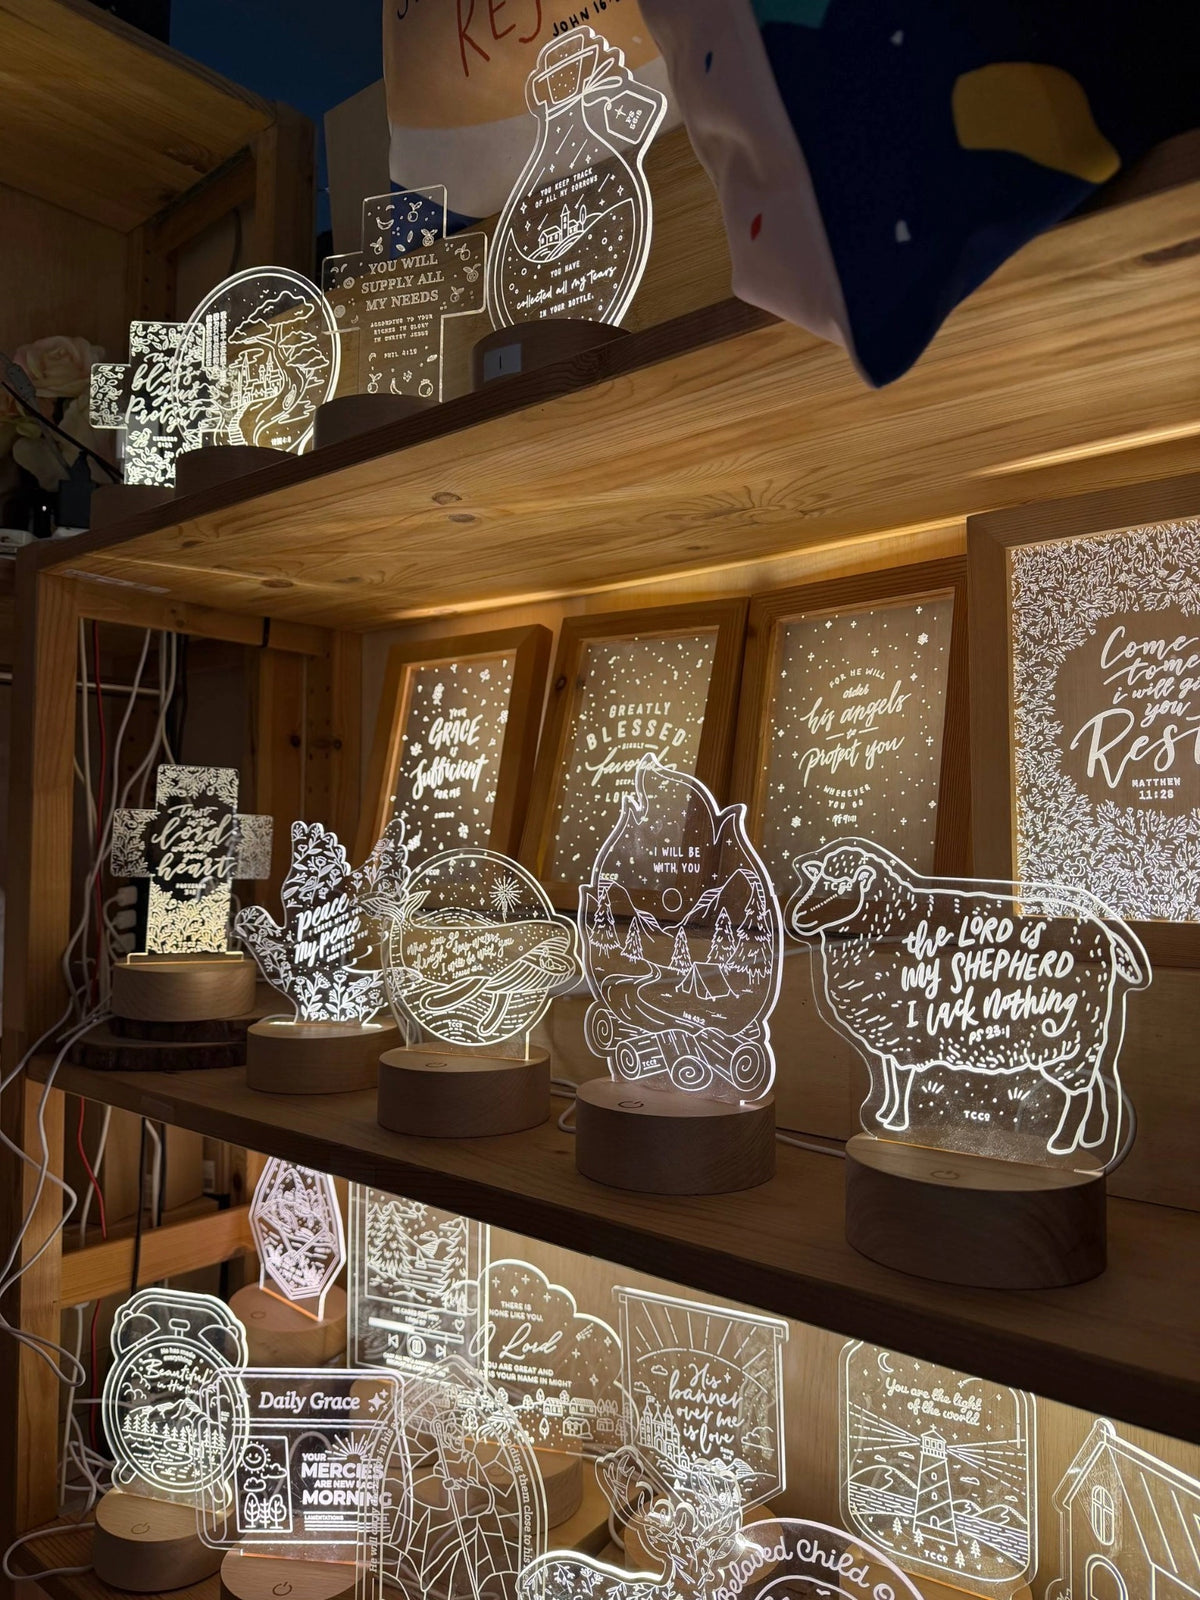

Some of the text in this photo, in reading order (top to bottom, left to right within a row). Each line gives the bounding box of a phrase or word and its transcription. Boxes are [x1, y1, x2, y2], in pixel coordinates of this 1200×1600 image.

[552, 12, 590, 38] JOHN
[535, 174, 598, 208] OF ALL MY SORROWS
[540, 167, 593, 197] YOU KEEP TRACK
[368, 253, 438, 275] YOU WILL
[550, 260, 580, 278] YOU HAVE
[361, 271, 444, 294] SUPPLY ALL
[516, 285, 552, 310] collected
[555, 280, 567, 294] all
[571, 275, 586, 292] my
[365, 289, 439, 312] MY NEEDS
[539, 309, 547, 318] IN
[550, 302, 565, 314] YOUR
[1101, 625, 1199, 669] Come
[829, 667, 886, 688] FOR HE WILL
[1131, 676, 1175, 700] will
[608, 702, 671, 719] GREATLY
[800, 680, 912, 734] his angels
[1140, 699, 1191, 728] you
[428, 713, 484, 751] GRACE
[586, 718, 686, 750] BLESSED
[865, 736, 905, 771] you
[823, 783, 871, 798] WHEREVER
[1131, 777, 1181, 788] MATTHEW
[1138, 789, 1175, 800] 11:28
[828, 798, 863, 810] YOU GO
[661, 846, 684, 857] WILL
[688, 846, 701, 858] BE
[155, 852, 238, 880] heart
[653, 862, 701, 873] WITH YOU
[445, 930, 460, 949] go
[902, 915, 1047, 960] the LORD is
[294, 940, 320, 968] my
[901, 949, 1075, 1000] my SHEPHERD
[906, 1000, 919, 1028] I
[983, 984, 1078, 1038] nothing
[985, 1024, 1011, 1040] 23:1
[489, 1308, 509, 1318] NONE
[510, 1311, 526, 1320] LIKE
[500, 1300, 532, 1311] THERE IS
[499, 1322, 563, 1361] Lord
[141, 1358, 210, 1386] Beautiful
[481, 1360, 554, 1377] YOU ARE GREAT AND
[496, 1371, 517, 1381] YOUR
[517, 1373, 539, 1384] NAME
[540, 1376, 548, 1385] IN
[548, 1378, 573, 1388] MIGHT
[688, 1362, 722, 1390] His
[668, 1369, 744, 1409] banner
[885, 1376, 983, 1414] You are the light
[258, 1390, 361, 1414] Daily Grace
[907, 1397, 981, 1427] of the world
[676, 1405, 745, 1428] over me
[683, 1423, 699, 1441] is
[699, 1422, 735, 1454] love
[301, 1452, 327, 1462] YOUR
[301, 1462, 384, 1480] MERCIES
[313, 1479, 356, 1489] ARE NEW
[518, 1473, 530, 1504] them
[302, 1489, 393, 1507] MORNING
[523, 1505, 534, 1533] close
[523, 1534, 533, 1546] to
[715, 1535, 871, 1600] Beloved Child
